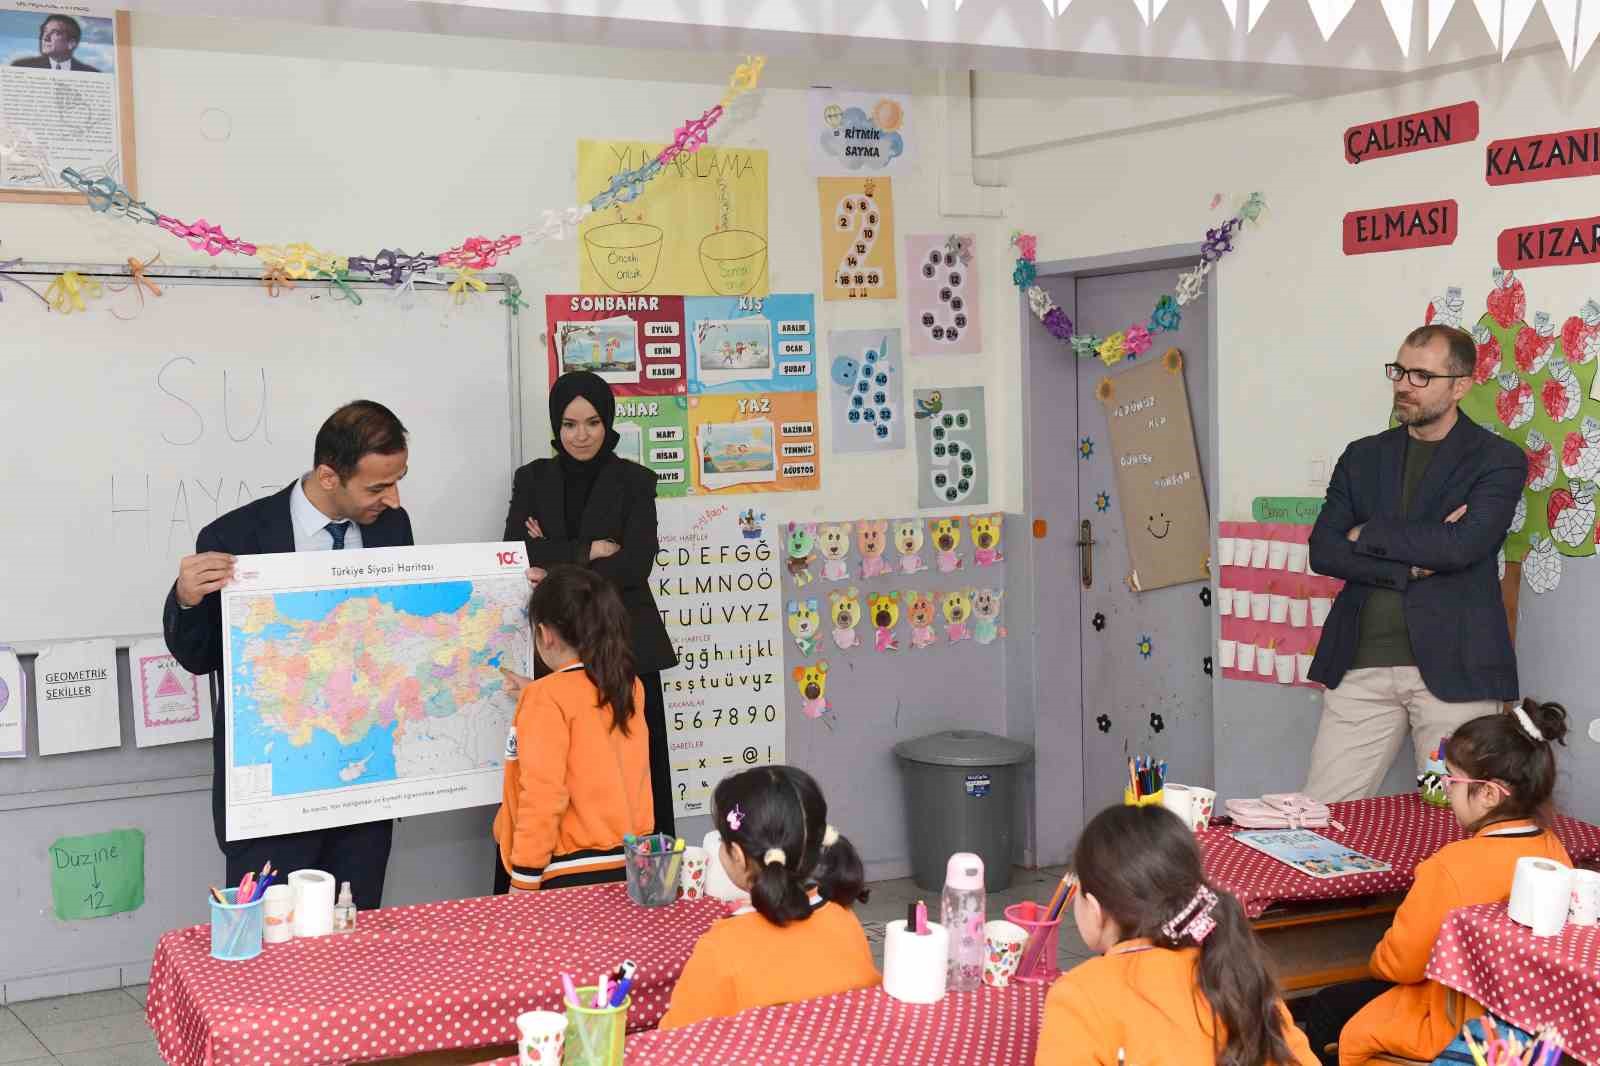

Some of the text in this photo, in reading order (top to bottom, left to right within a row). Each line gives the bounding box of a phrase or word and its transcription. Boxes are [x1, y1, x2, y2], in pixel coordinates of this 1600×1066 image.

[844, 126, 880, 140] RİTMİK
[1348, 114, 1451, 164] ÇALIŞAN
[845, 146, 880, 158] SAYMA
[1356, 207, 1448, 242] ELMASI
[570, 296, 659, 311] SONBAHAR
[652, 325, 673, 334] EYLÜL
[654, 346, 672, 354] EKİM
[786, 344, 803, 352] OCAK
[652, 368, 675, 376] KASIM
[784, 364, 806, 374] ŞUBAT
[158, 357, 272, 446] SU
[737, 399, 770, 414] YAZ
[656, 430, 676, 438] MART
[782, 424, 812, 434] HAZİRAN
[784, 445, 812, 454] TEMMUZ
[656, 451, 678, 460] NİSAN
[656, 472, 680, 480] MAYIS
[332, 566, 364, 577] Türkiye
[368, 564, 394, 576] Siyasi
[84, 891, 112, 910] 12
